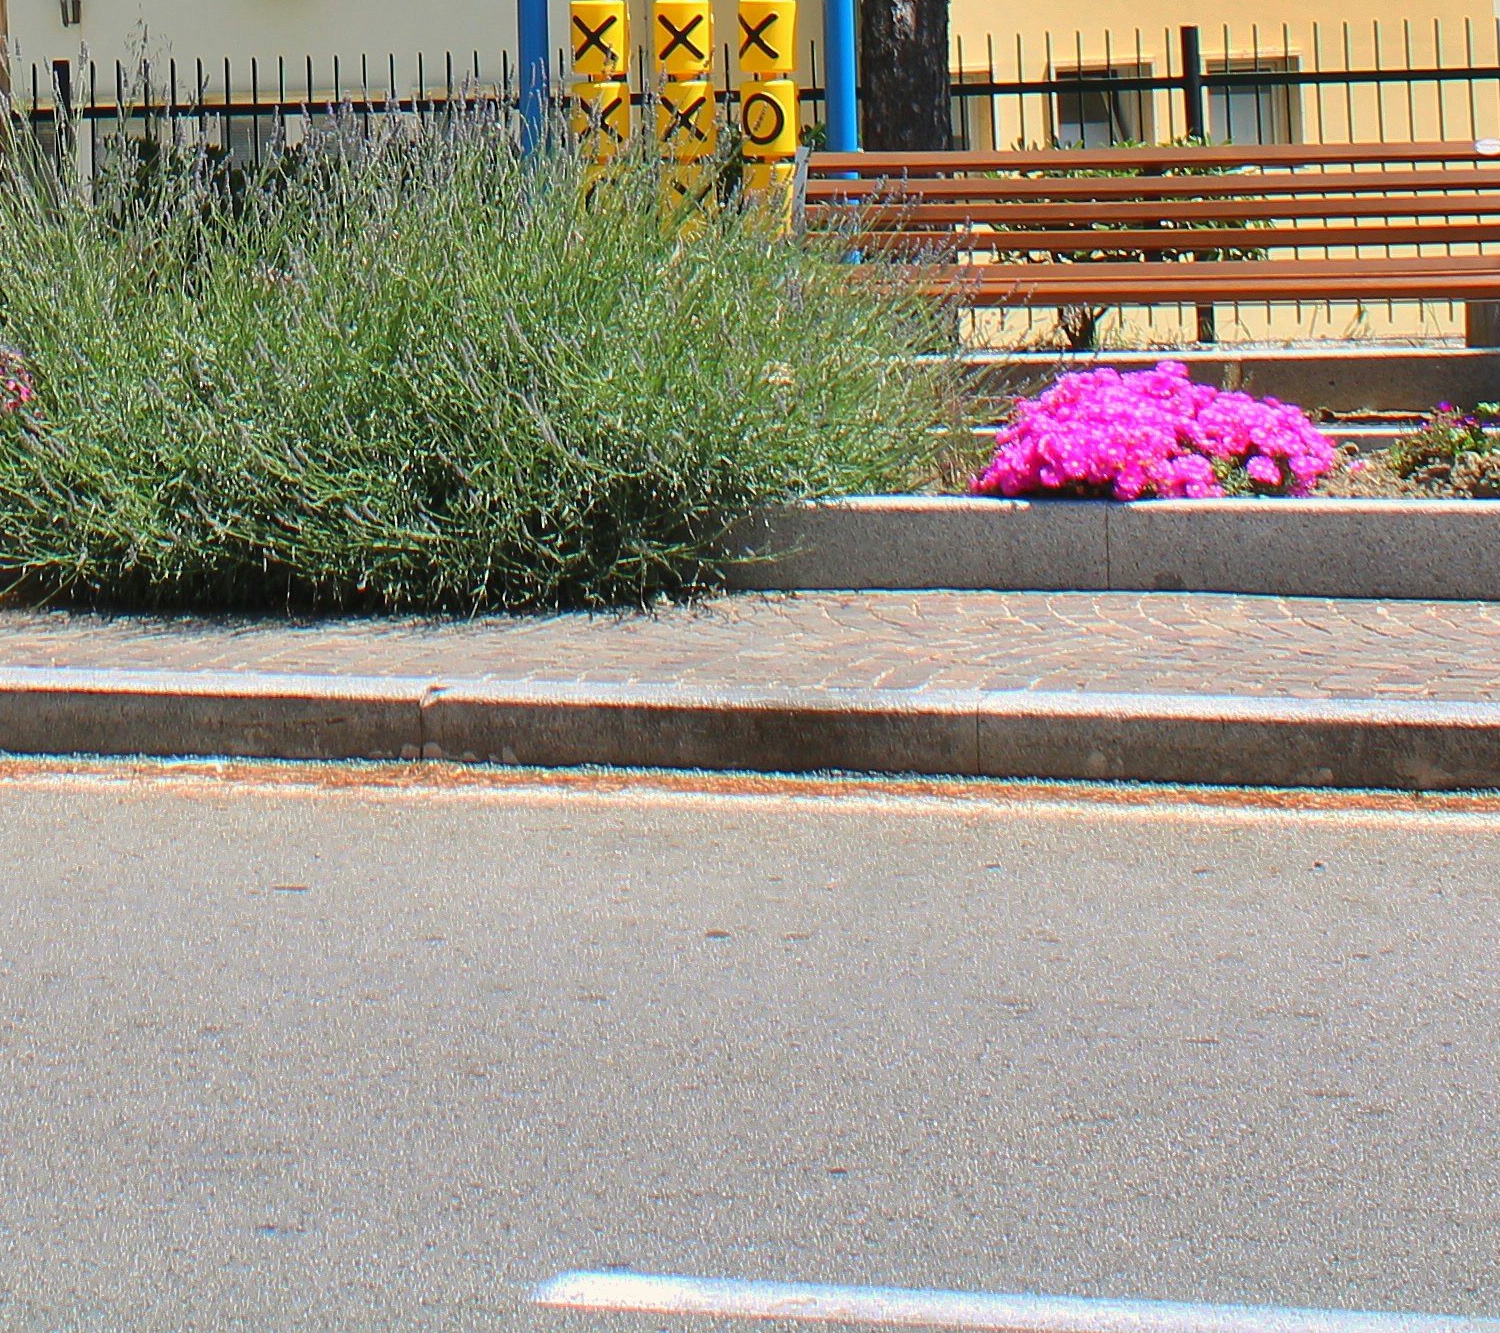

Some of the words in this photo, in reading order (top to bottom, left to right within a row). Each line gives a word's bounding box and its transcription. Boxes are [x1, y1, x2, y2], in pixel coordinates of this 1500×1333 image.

[572, 14, 617, 61] X
[658, 14, 705, 61] X
[738, 13, 779, 59] X
[660, 96, 707, 143] X
